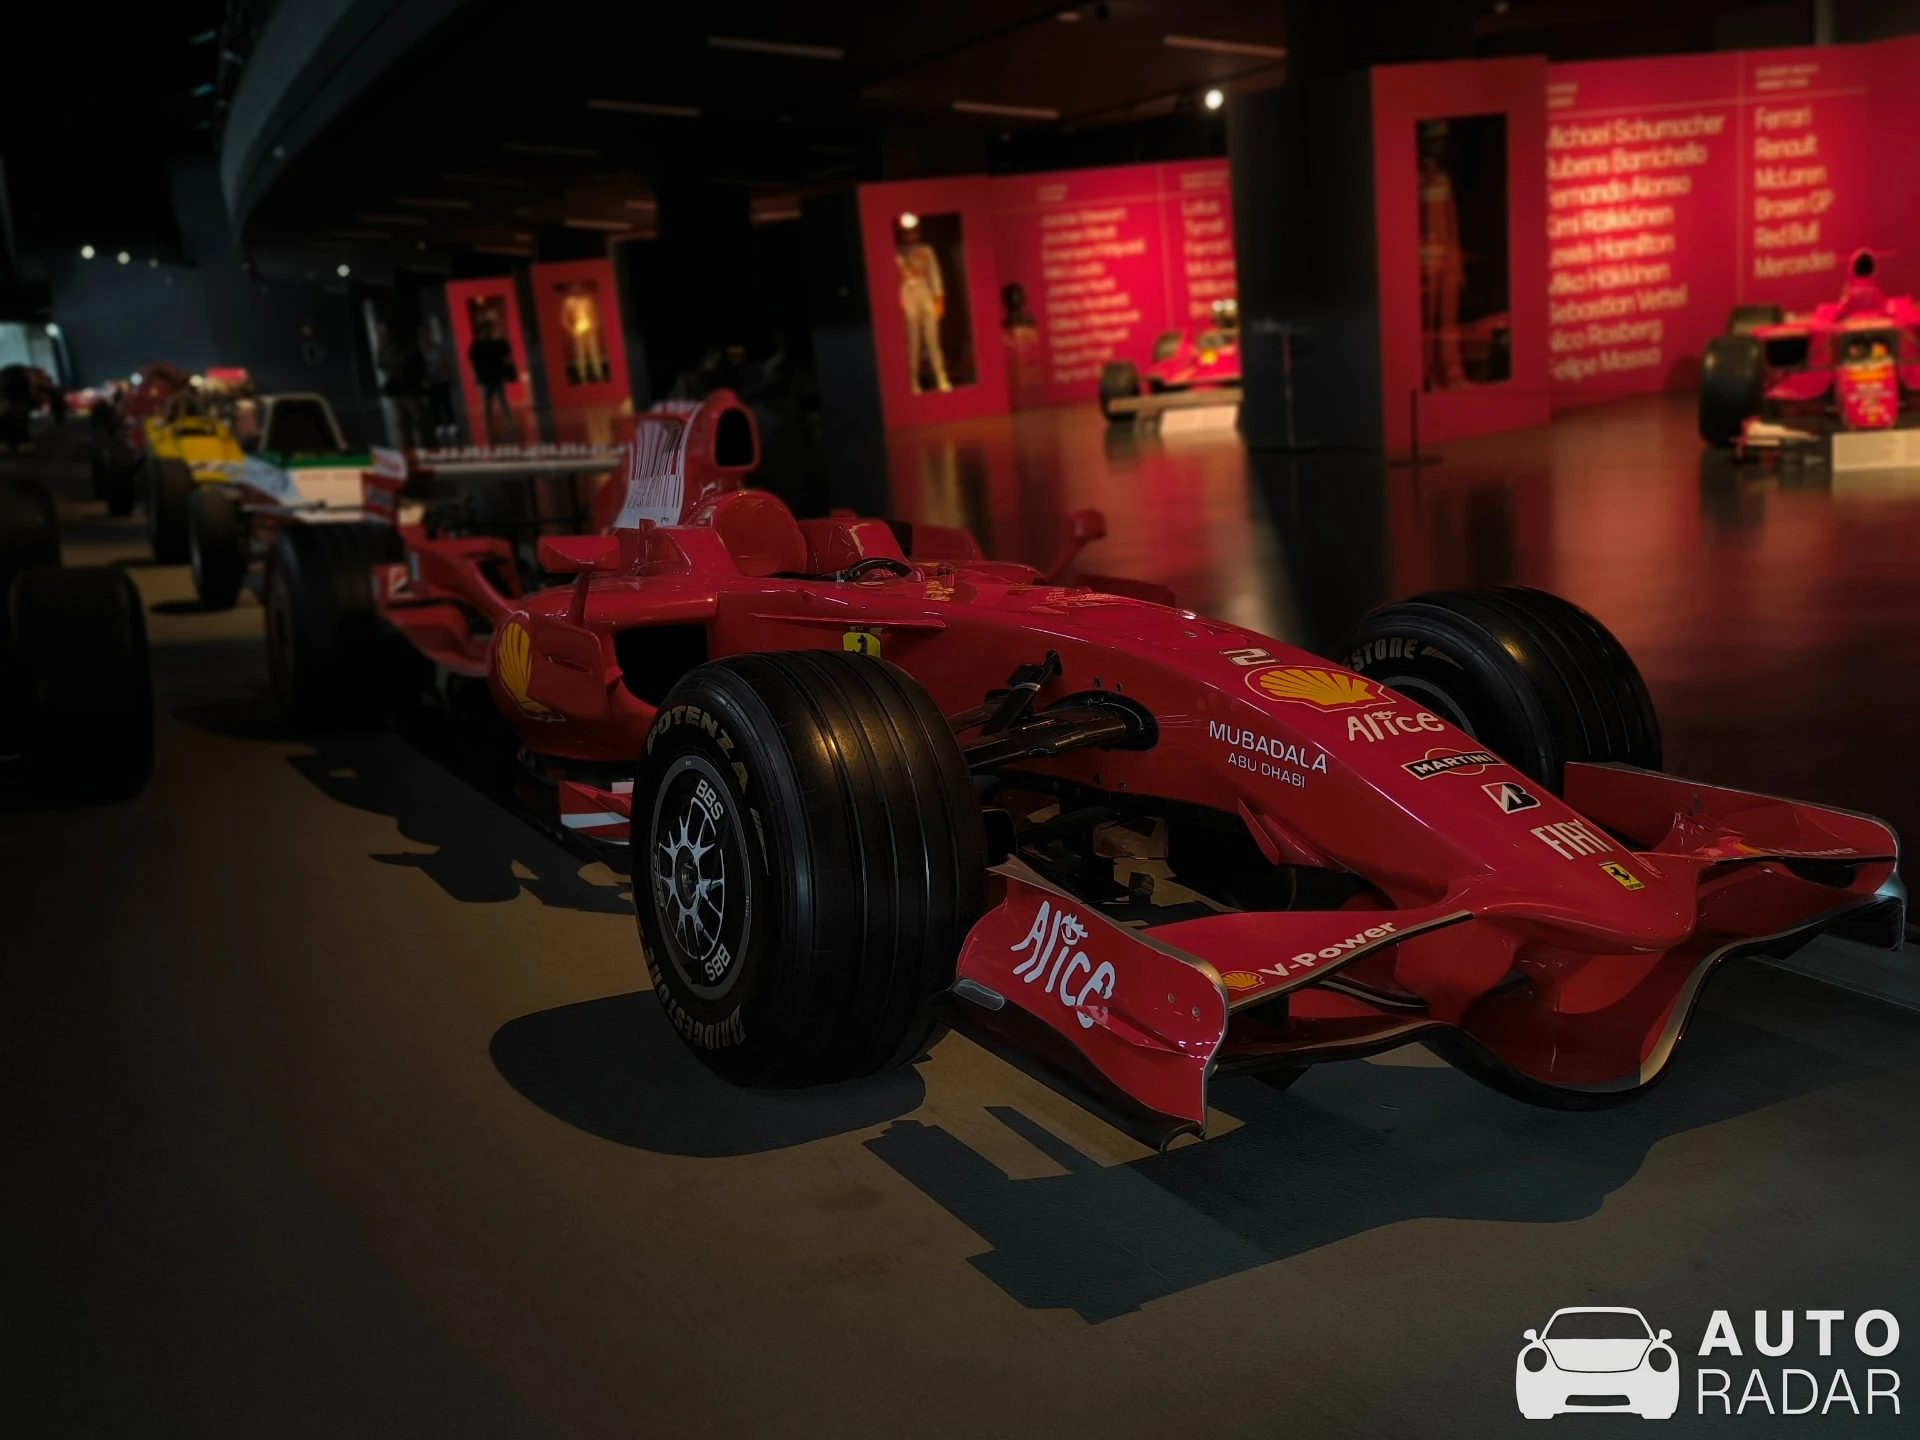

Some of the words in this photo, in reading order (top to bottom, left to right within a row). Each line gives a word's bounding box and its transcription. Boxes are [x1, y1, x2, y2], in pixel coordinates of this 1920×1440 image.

[1612, 113, 1725, 144] Schumacher
[1548, 177, 1629, 209] ernando
[1551, 355, 1598, 383] elipe
[1346, 637, 1419, 672] STONE
[1208, 719, 1329, 775] MUBADALA
[1347, 711, 1445, 743] Alice
[646, 705, 748, 795] POTENZA
[1413, 753, 1494, 775] MARTINI
[1227, 752, 1258, 773] ABU
[1260, 761, 1305, 789] DHABI
[695, 778, 724, 821] BBS
[1529, 820, 1615, 861] FIAT
[704, 942, 731, 982] BBS
[1010, 901, 1116, 1029] Alice
[1257, 921, 1398, 979] V-Power
[645, 946, 746, 1051] BRIDGESTONE
